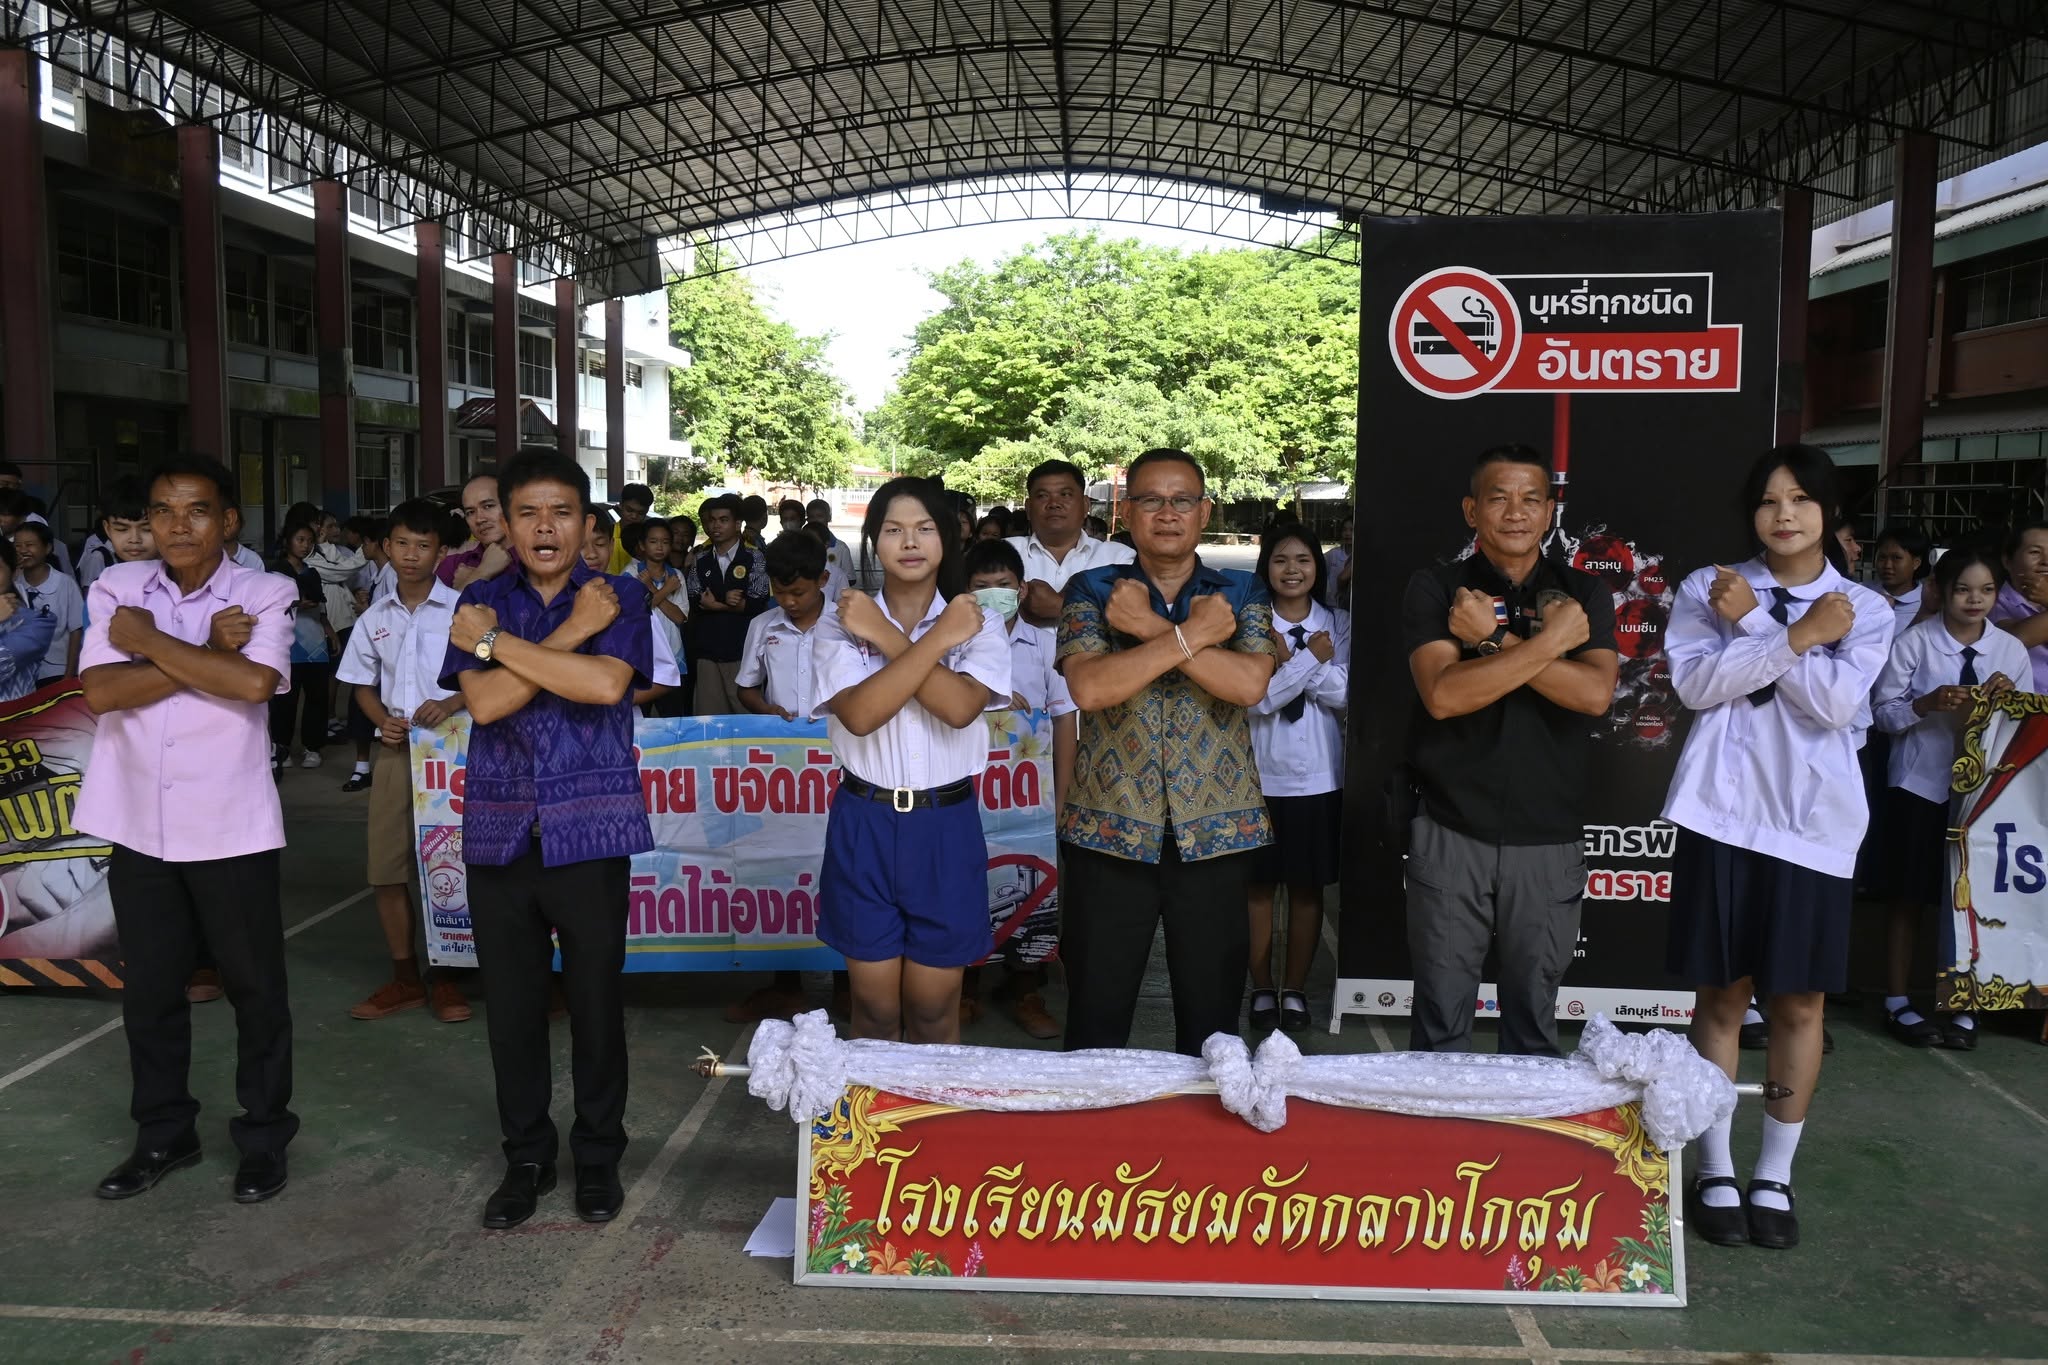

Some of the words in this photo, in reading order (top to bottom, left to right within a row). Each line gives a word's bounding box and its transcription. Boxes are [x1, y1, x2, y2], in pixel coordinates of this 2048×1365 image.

[1528, 279, 1693, 324] บุหรี่ทุกชนิด
[1536, 338, 1720, 381] อันตราย
[1584, 560, 1622, 573] สารหนู
[1620, 622, 1657, 633] เบนซีน
[10, 769, 24, 782] IT
[1585, 872, 1671, 898] ตราย
[626, 865, 821, 934] ทิดไท้องค์
[1615, 1003, 1659, 1019] เลิกบุหรี่
[1661, 1006, 1683, 1018] โทร.
[1685, 1007, 1696, 1018] ฟ
[875, 1140, 1603, 1283] โรงเรียนมัธยมวัดกลางโกสุม
